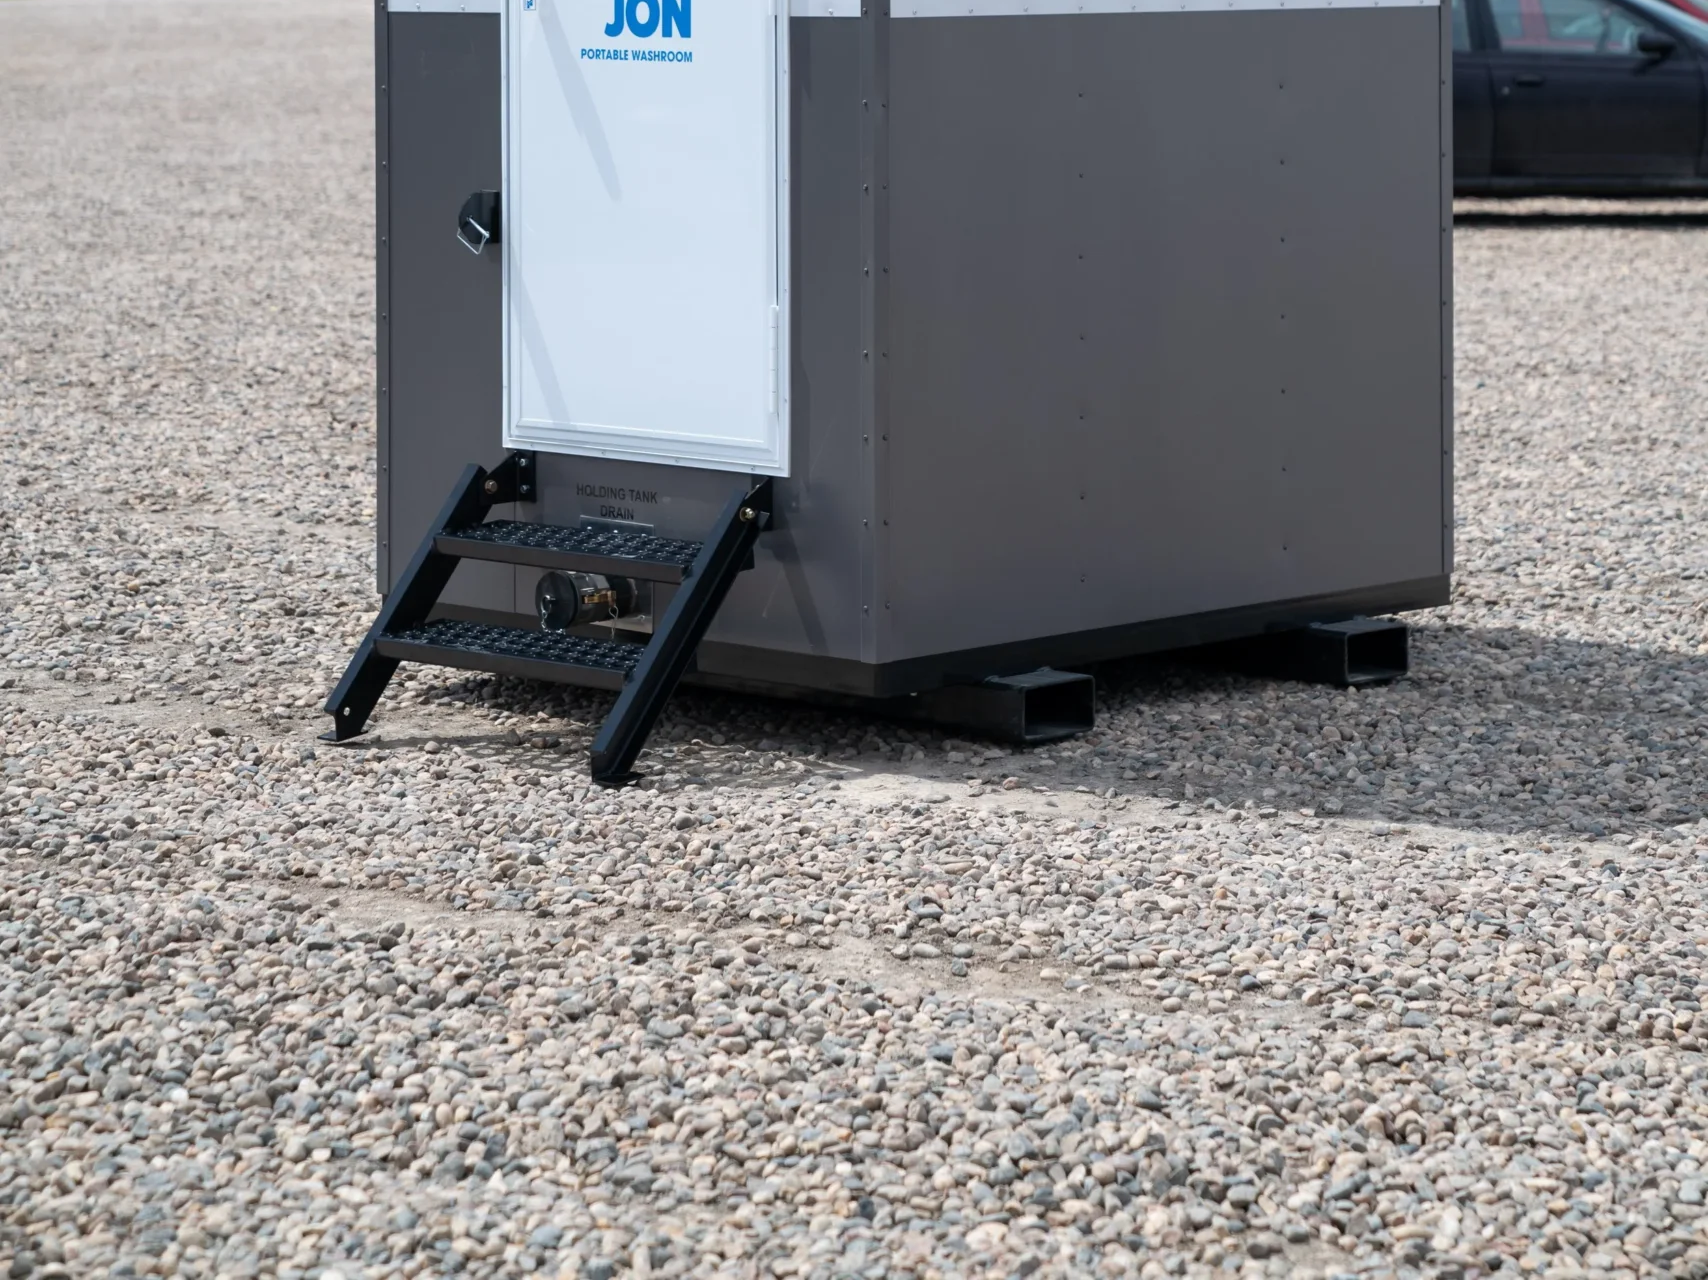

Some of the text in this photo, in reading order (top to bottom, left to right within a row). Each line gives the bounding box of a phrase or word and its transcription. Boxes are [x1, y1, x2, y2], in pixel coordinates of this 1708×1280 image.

[580, 48, 693, 62] PORTABLE WASHROOM
[576, 483, 658, 504] HOLDING TANK
[600, 505, 634, 520] DRAIN
